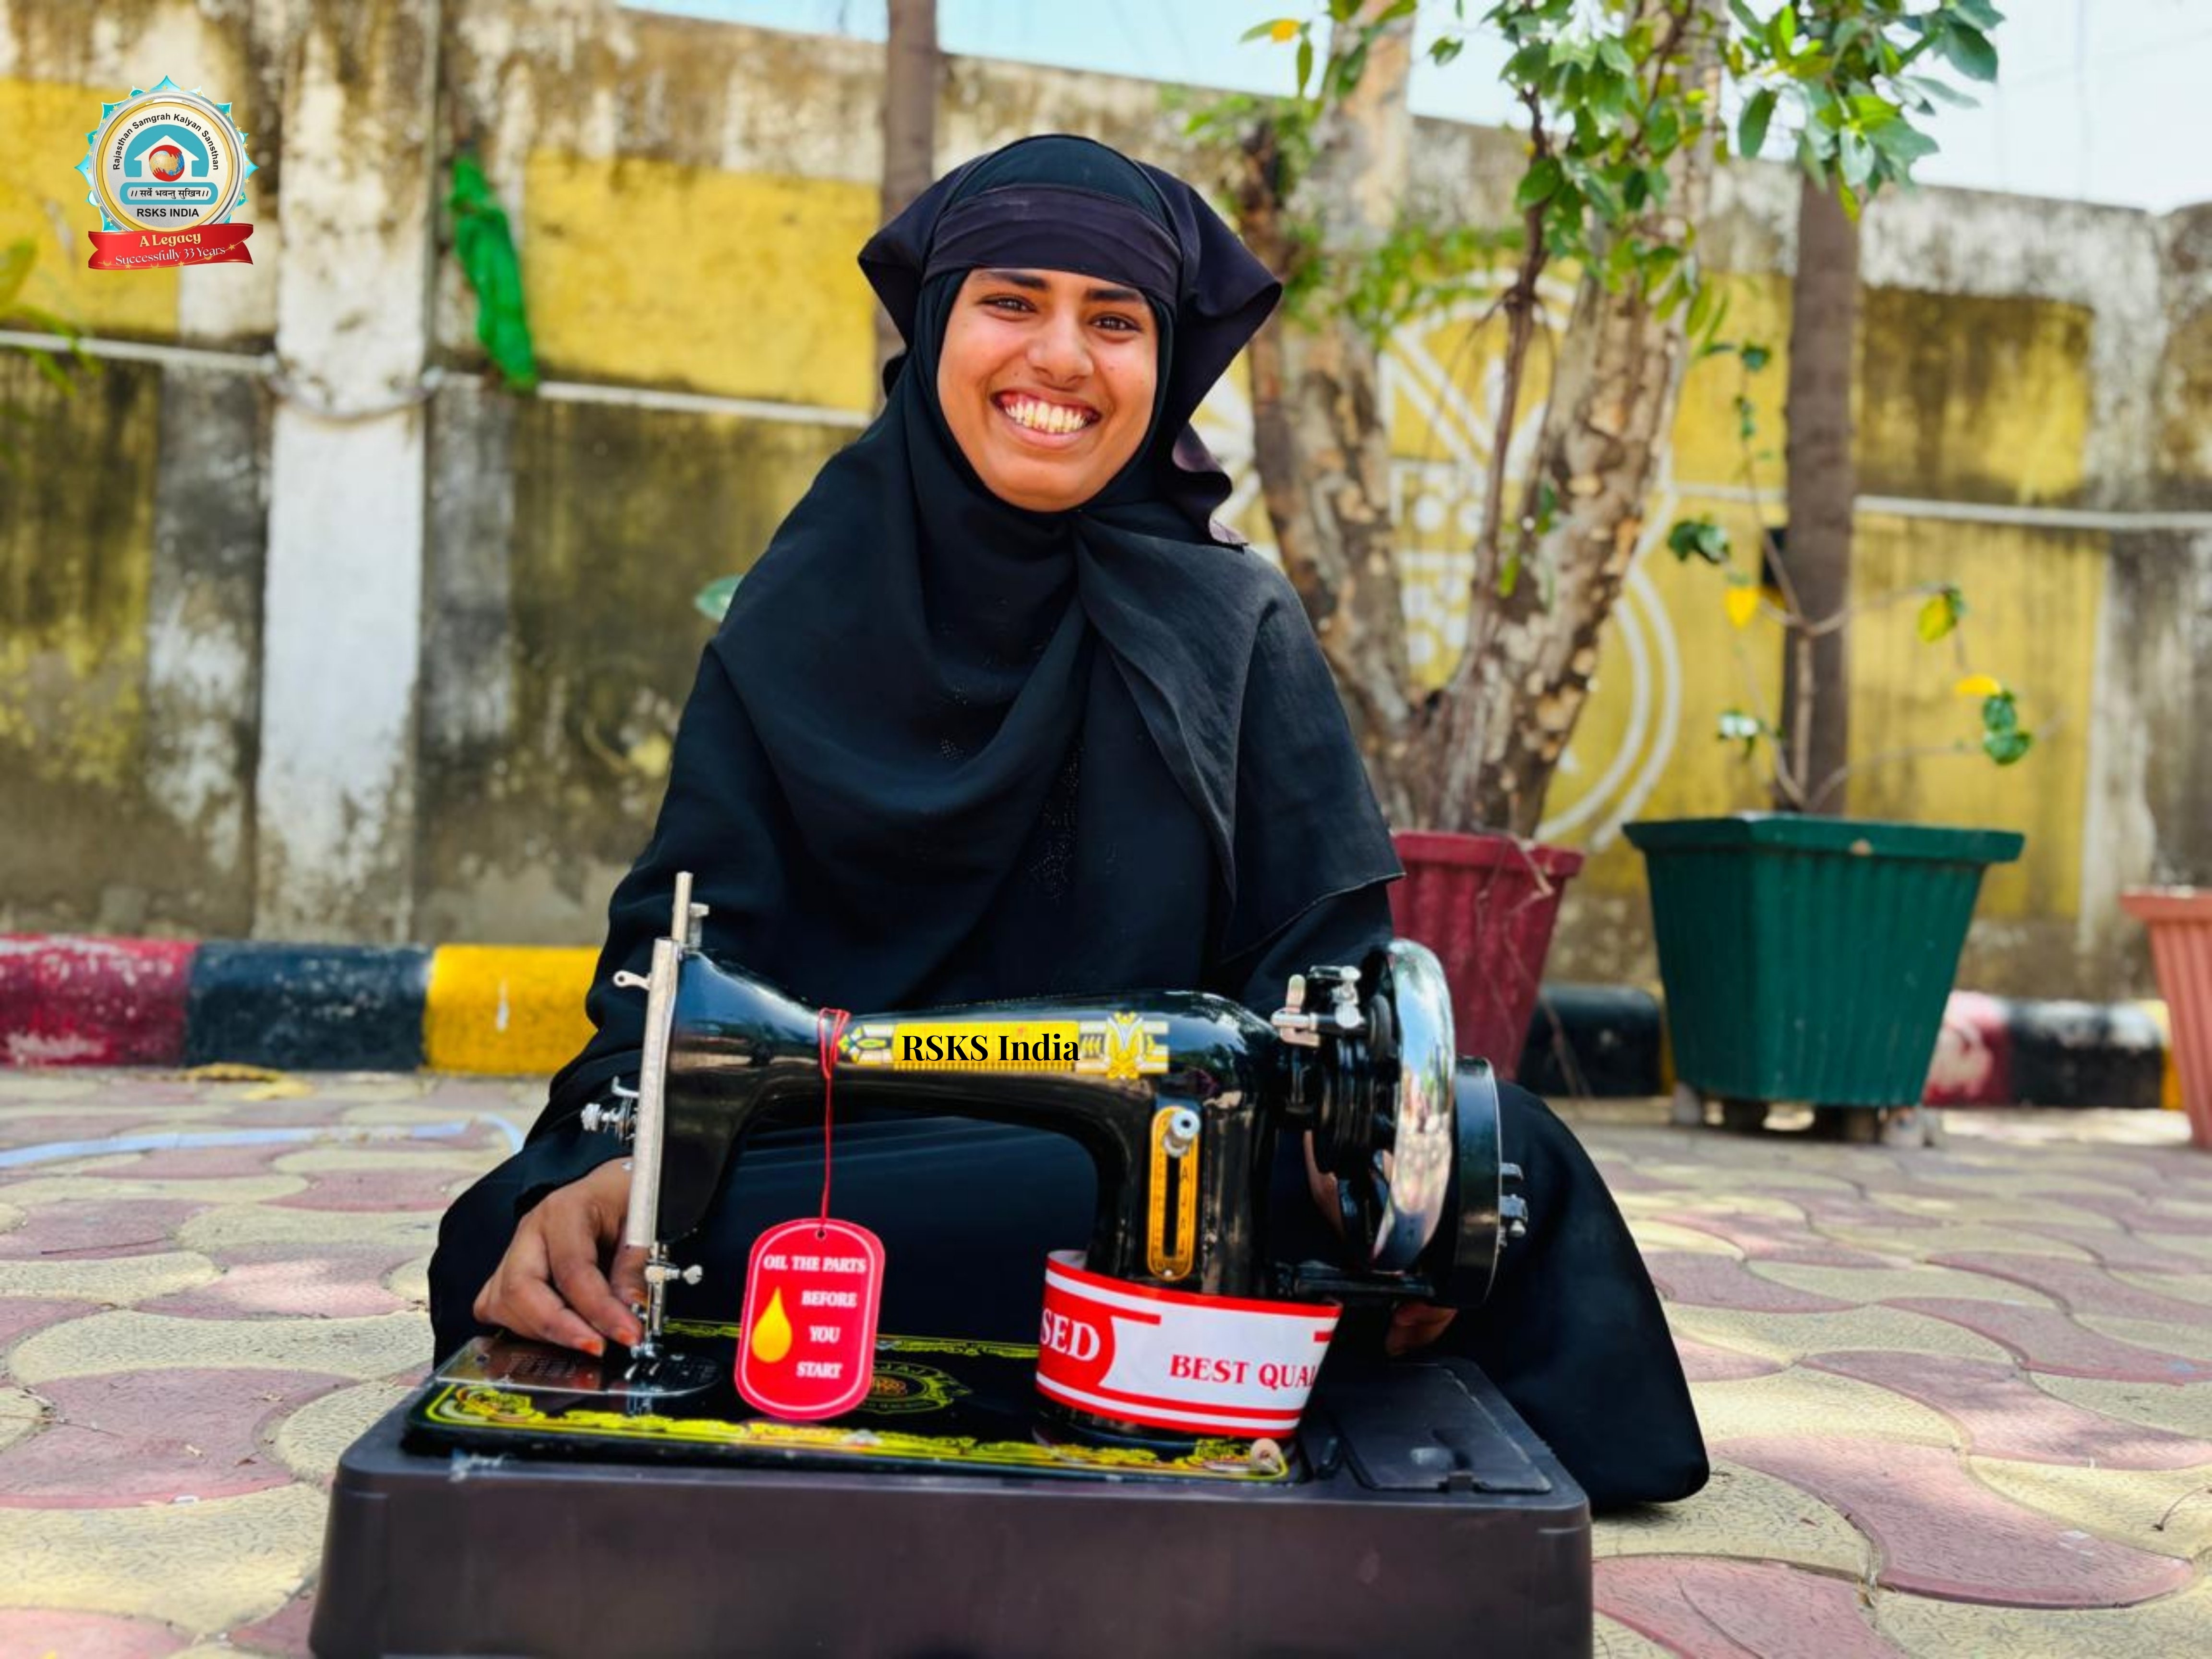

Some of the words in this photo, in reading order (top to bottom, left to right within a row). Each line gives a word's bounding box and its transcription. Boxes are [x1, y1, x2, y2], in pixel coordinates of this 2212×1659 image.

[763, 1255, 788, 1270] OIL
[791, 1256, 820, 1272] THE
[822, 1258, 866, 1273] PARTS
[802, 1290, 857, 1308] BEFORE
[810, 1326, 841, 1343] YOU
[796, 1362, 843, 1379] START
[1169, 1354, 1250, 1384] BEST
